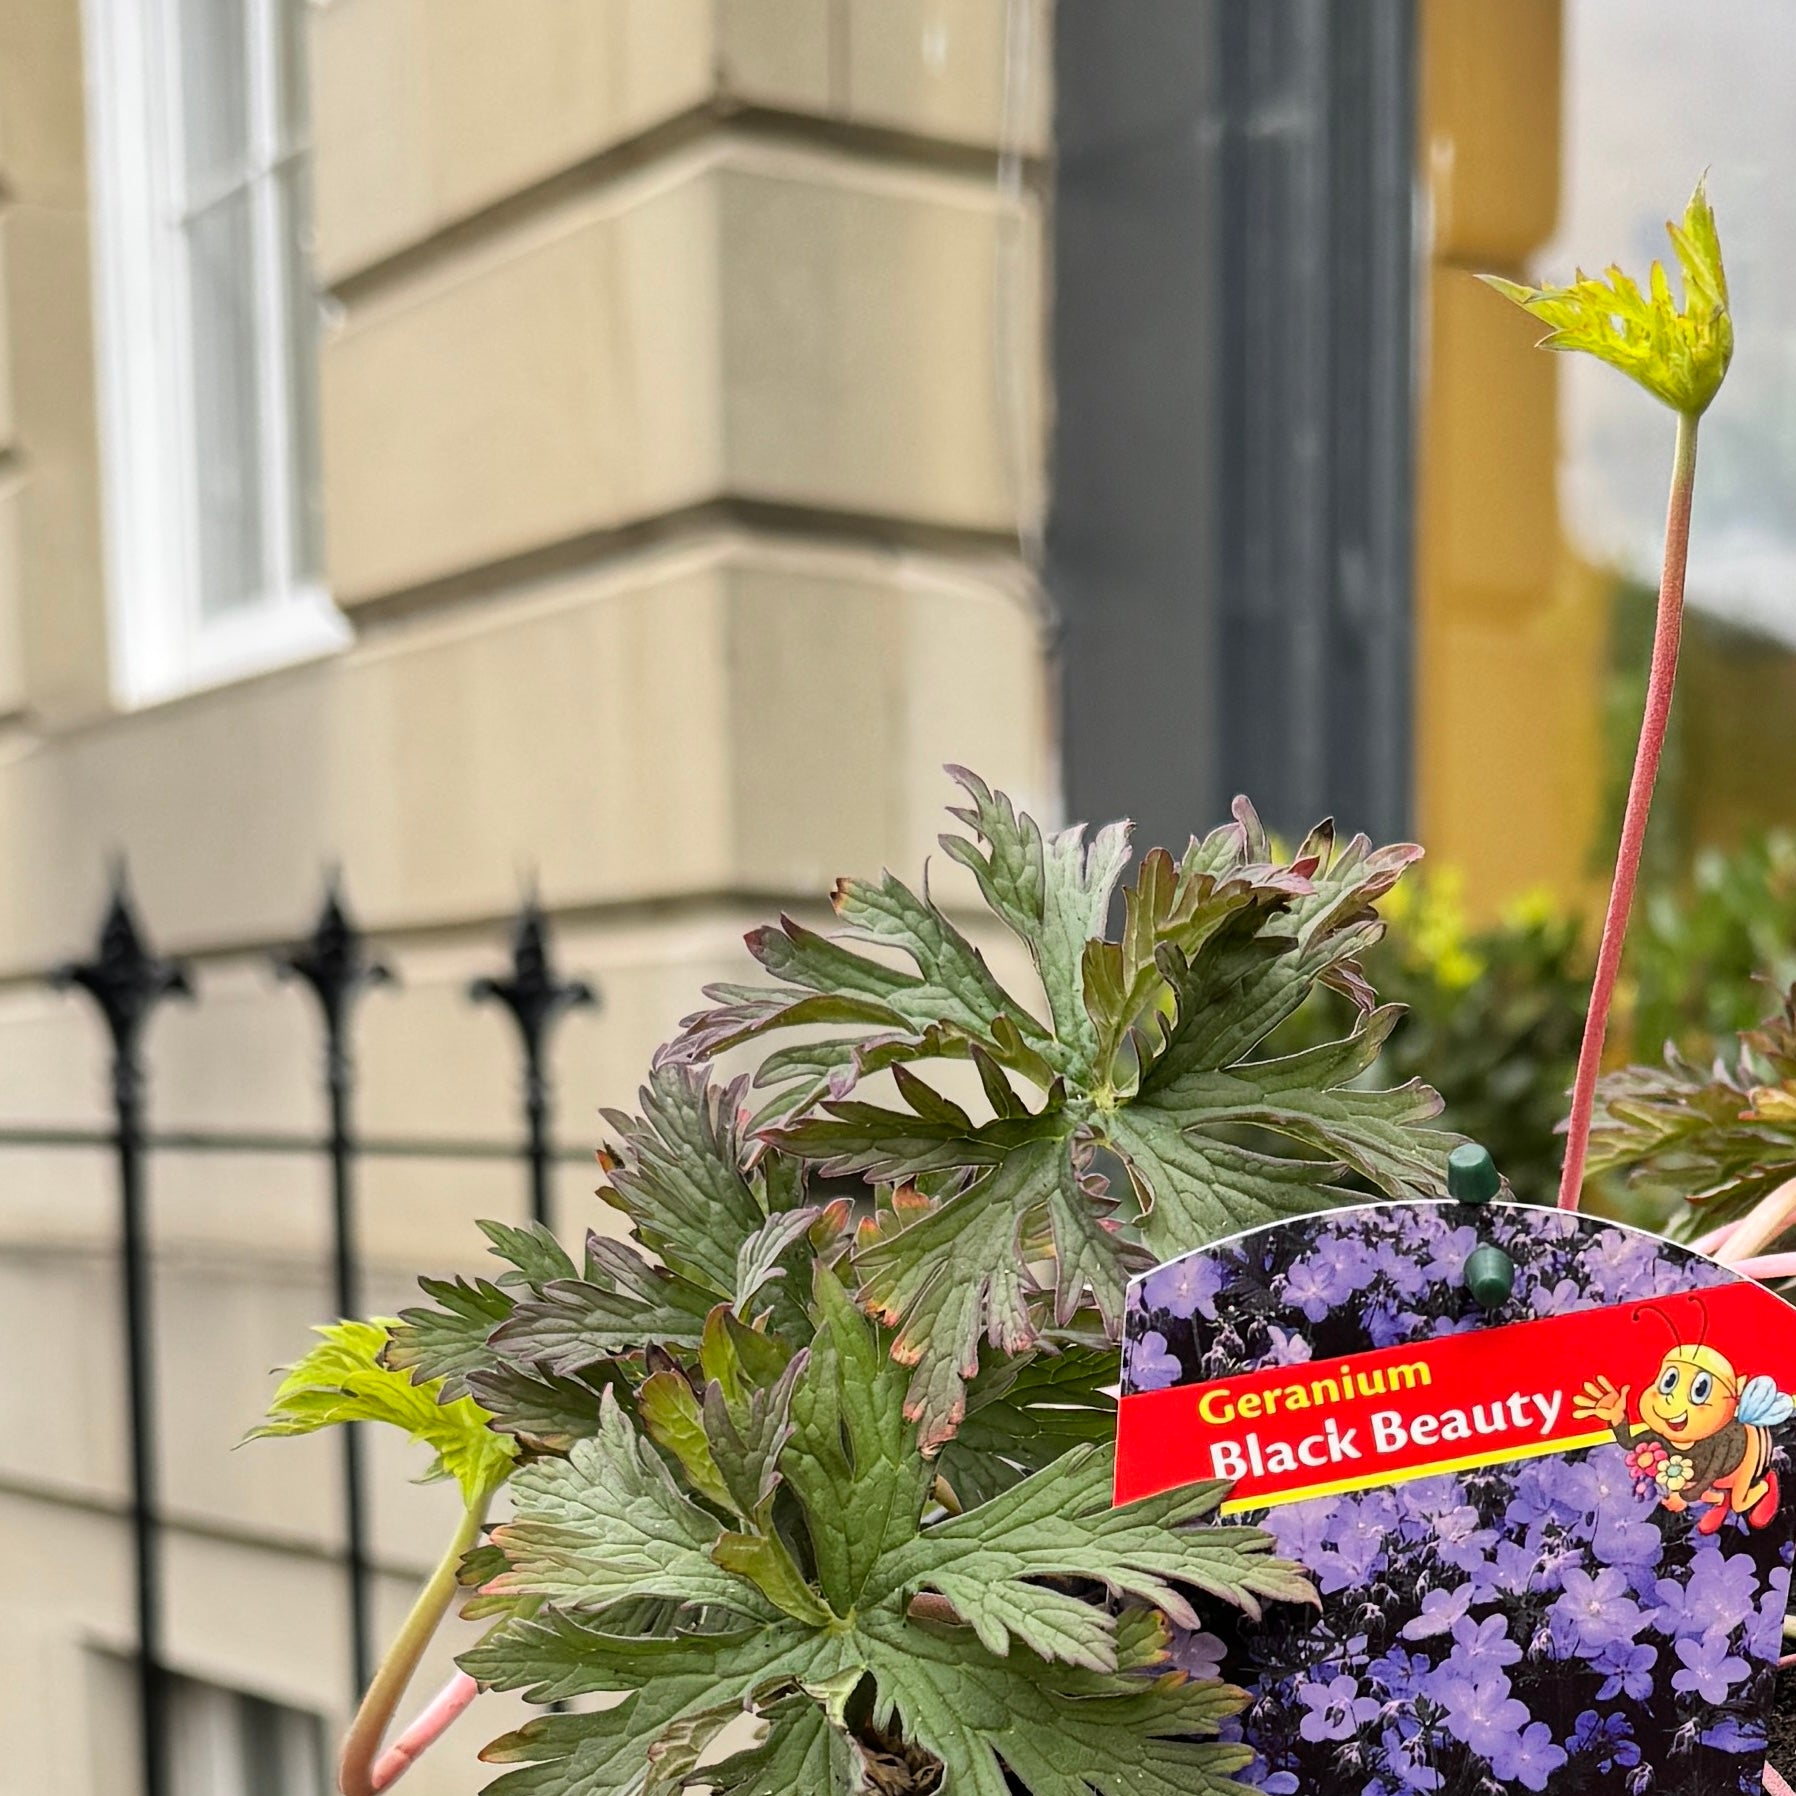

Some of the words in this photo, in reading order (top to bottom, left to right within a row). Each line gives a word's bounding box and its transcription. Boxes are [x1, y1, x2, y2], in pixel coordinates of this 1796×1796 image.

[1199, 1361, 1432, 1425] Geranium
[1210, 1417, 1362, 1481] Black
[1371, 1389, 1563, 1454] Beauty
